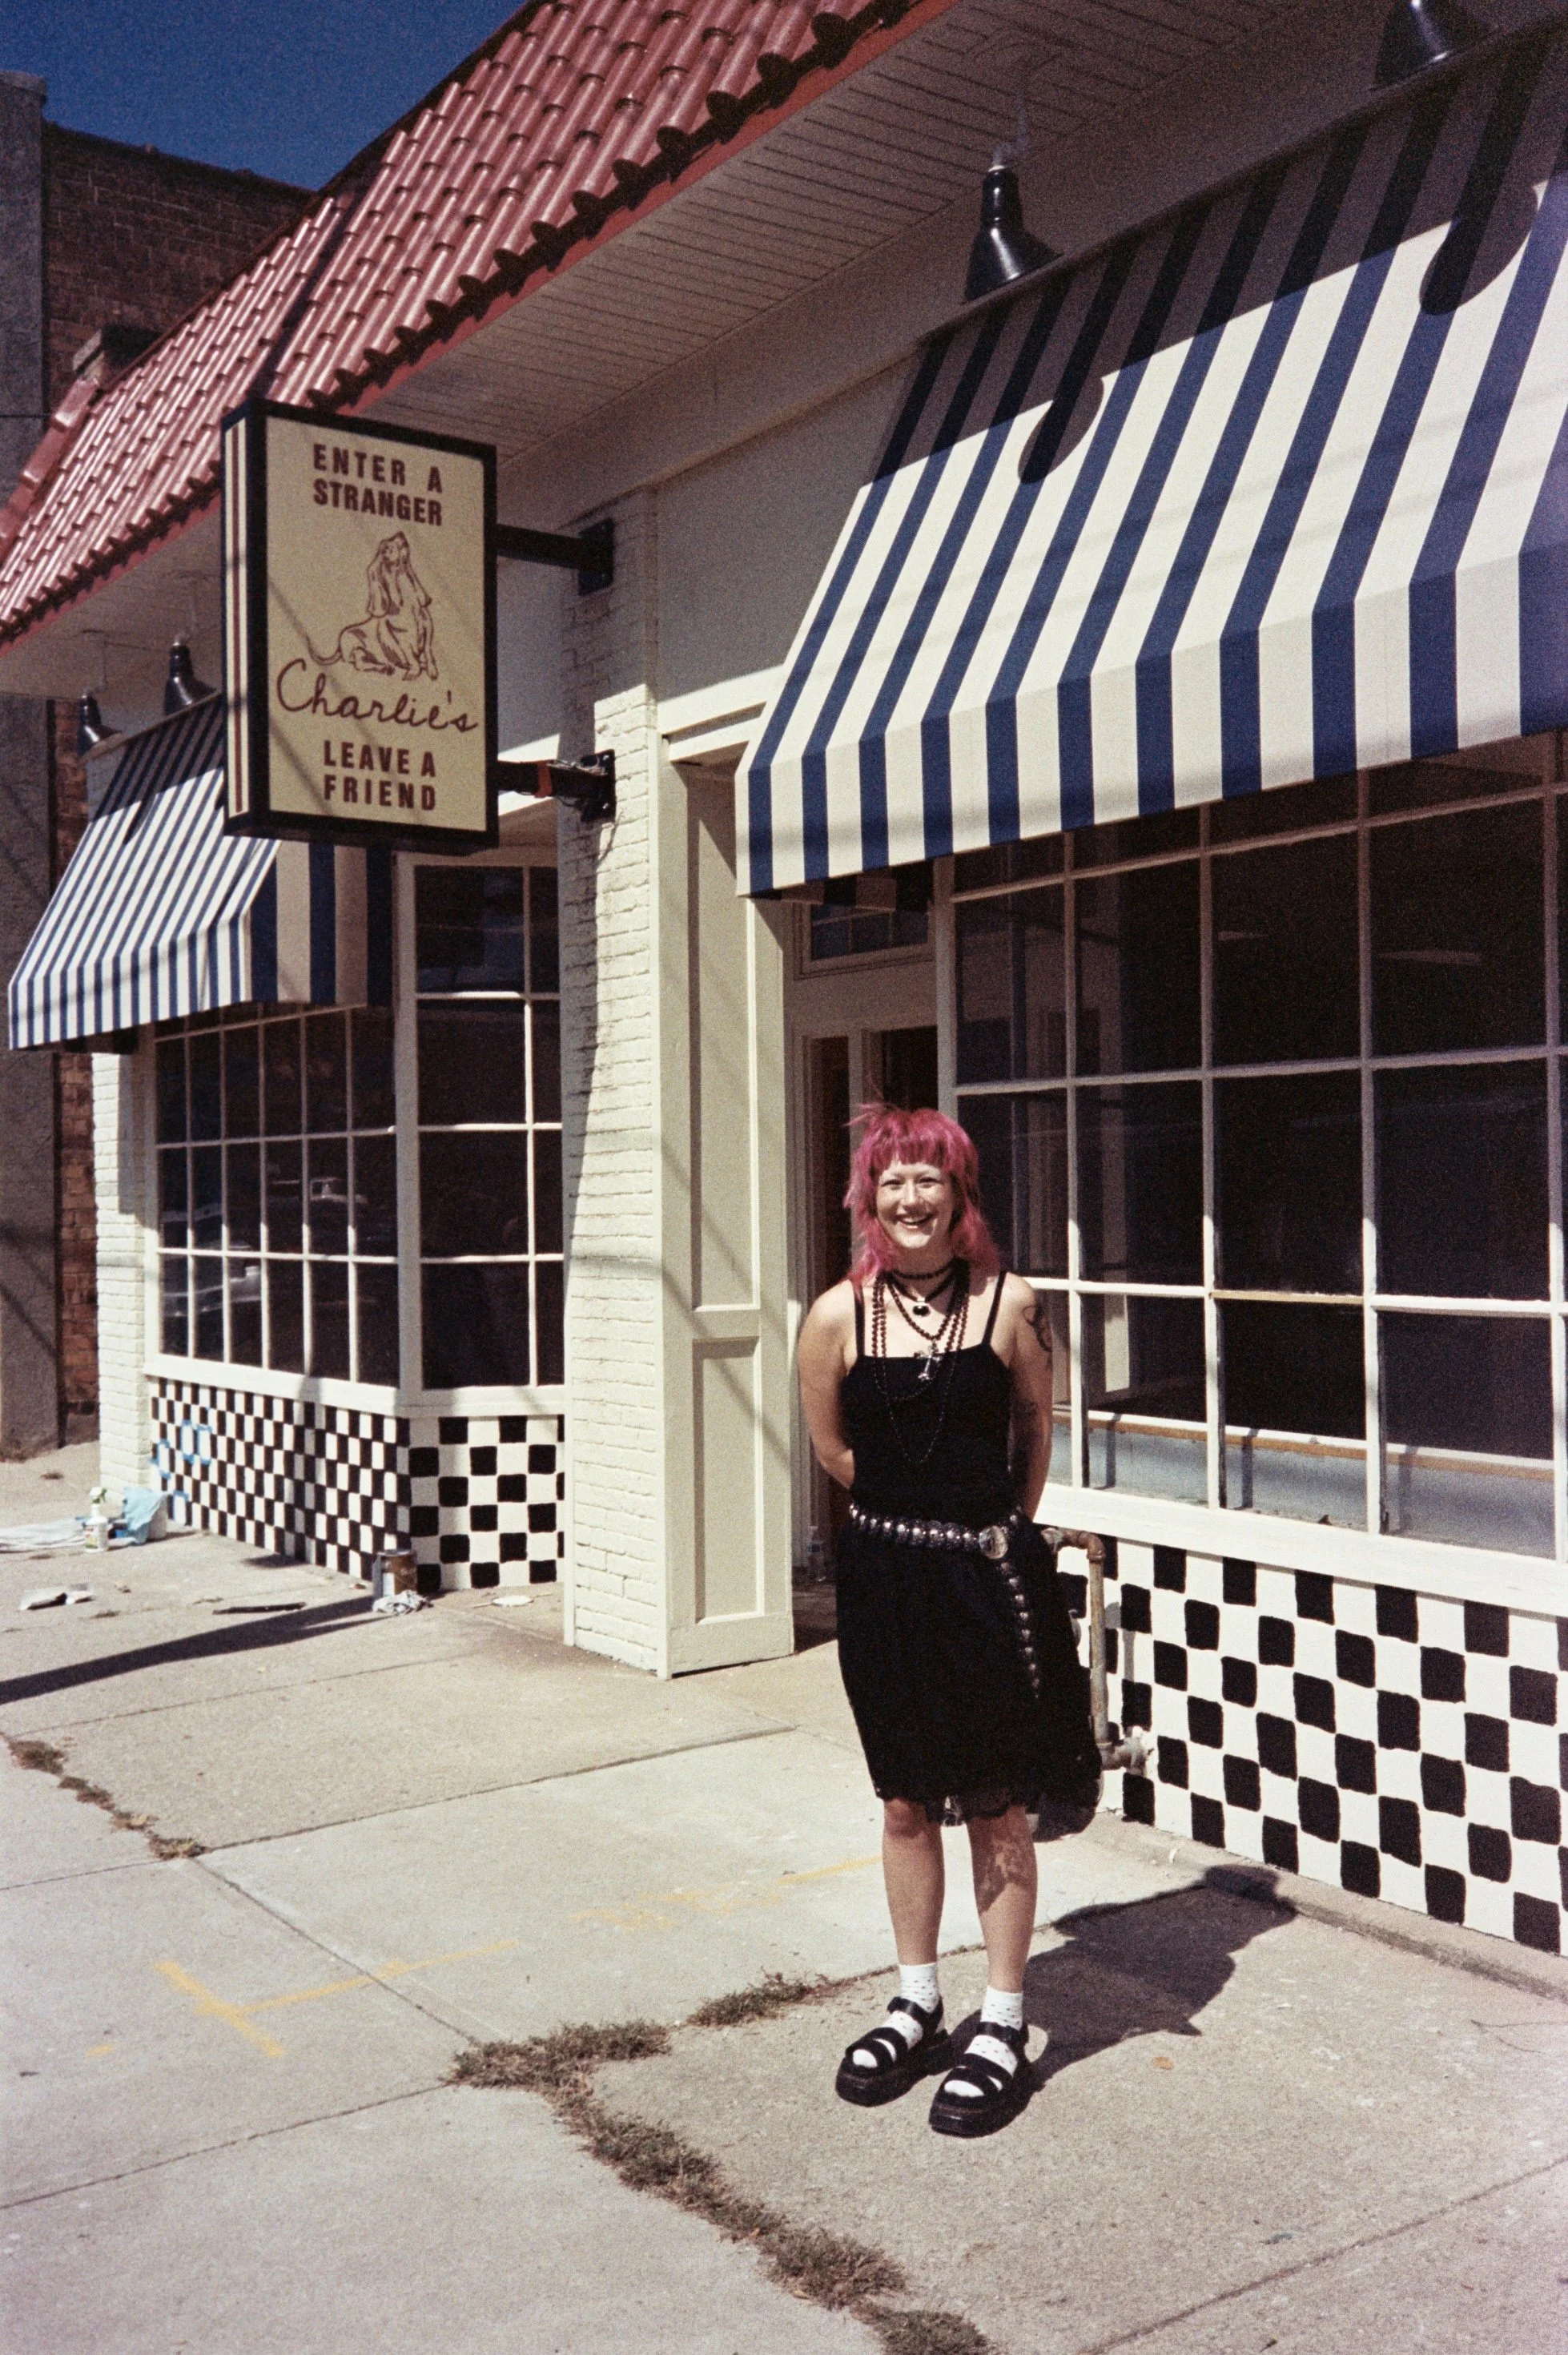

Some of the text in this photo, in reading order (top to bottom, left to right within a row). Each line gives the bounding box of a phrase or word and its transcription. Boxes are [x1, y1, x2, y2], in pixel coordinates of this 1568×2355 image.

[314, 443, 443, 493] ENTER A
[313, 478, 442, 526] STRANGER
[276, 658, 478, 732] Charlie's
[324, 740, 436, 778] LEAVE A
[324, 775, 436, 811] FRIEND
